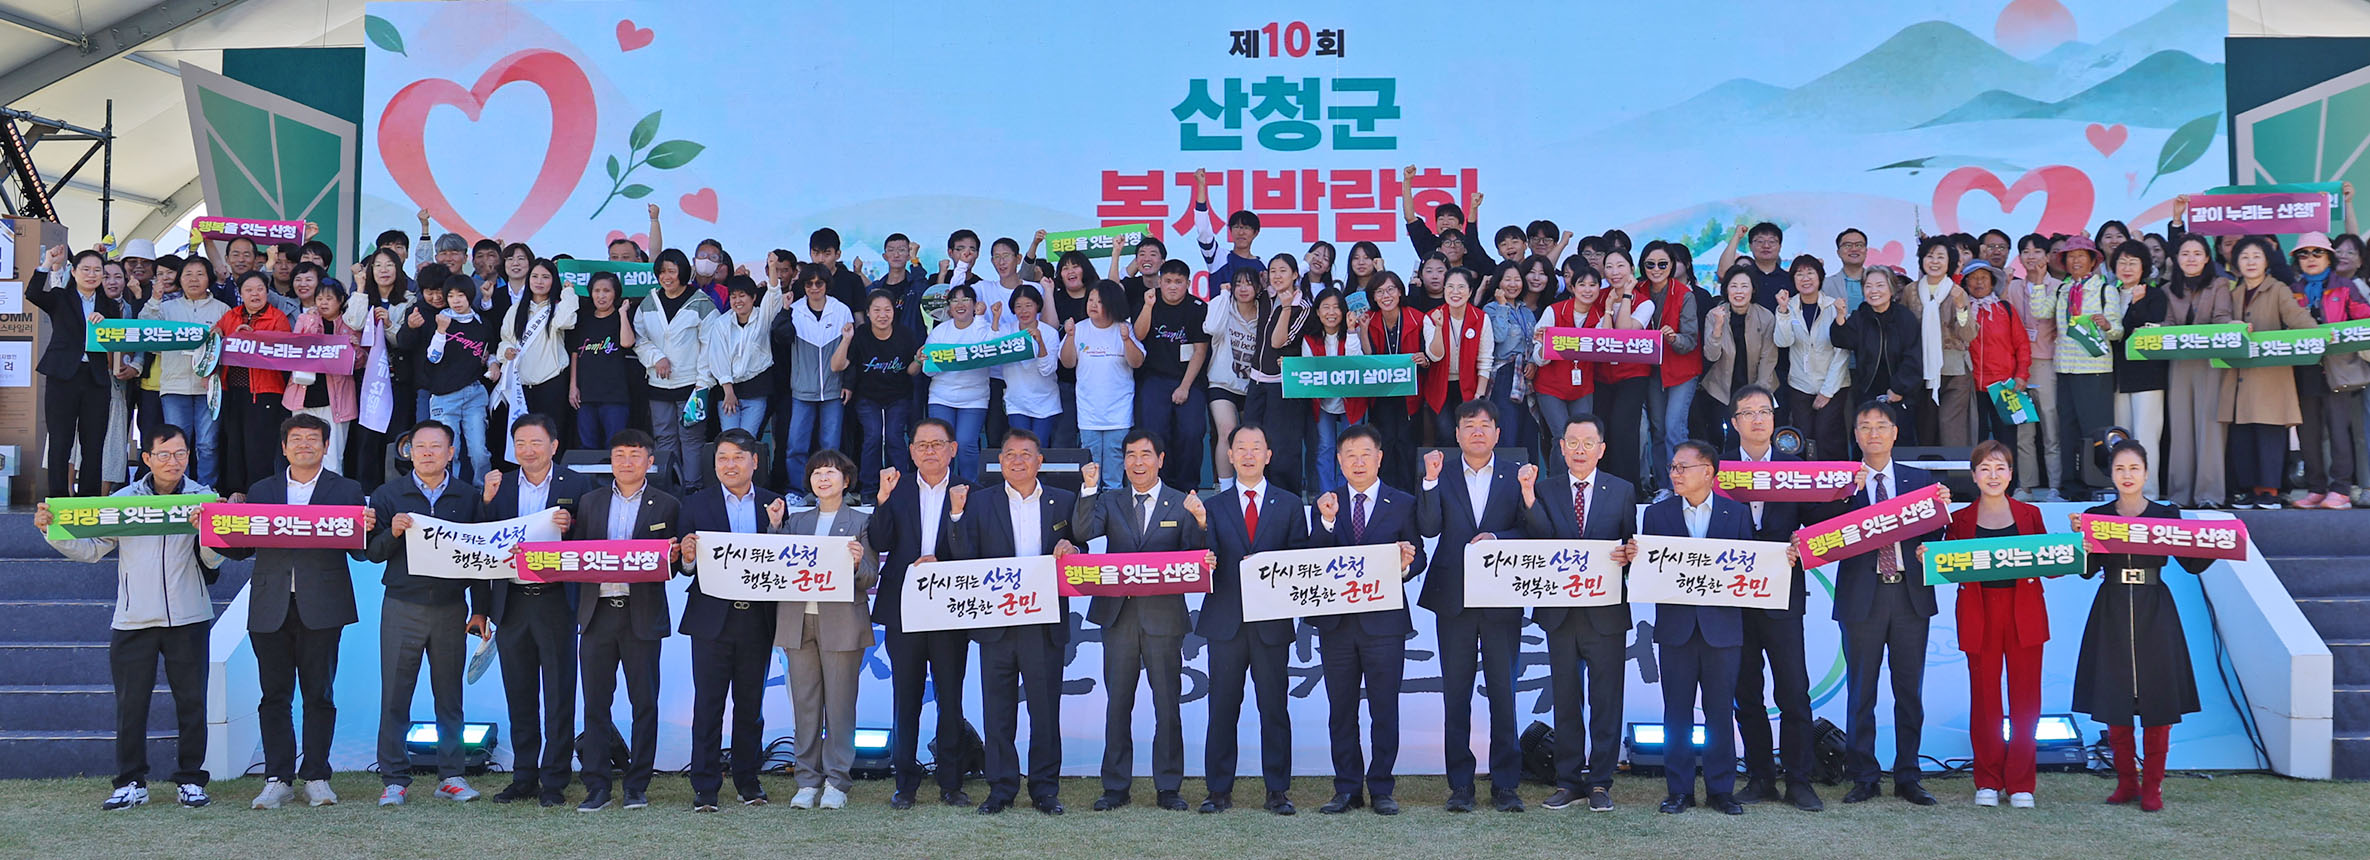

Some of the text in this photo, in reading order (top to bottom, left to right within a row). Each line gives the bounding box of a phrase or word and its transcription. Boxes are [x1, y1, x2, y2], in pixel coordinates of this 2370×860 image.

[1229, 21, 1345, 58] 제10회
[1172, 76, 1401, 151] 산청군
[2191, 206, 2223, 222] 같이
[2226, 205, 2273, 220] 누리는
[199, 220, 297, 240] 행복을 잇는 산청
[1051, 236, 1088, 252] 희망을
[1090, 234, 1113, 249] 잇는
[95, 326, 203, 343] 안부를 잇는 산청
[1551, 334, 1654, 355] 행복을 잇는 산청
[2134, 332, 2242, 352] 희망을 잇는 산청
[225, 338, 256, 354] 같이
[258, 342, 303, 358] 누리는
[578, 336, 618, 358] family
[929, 338, 1027, 364] 안부를 잇는 산청
[2260, 340, 2292, 357] 잇는
[2294, 338, 2326, 355] 산청
[863, 356, 905, 373] family
[1330, 370, 1360, 385] 여기
[1363, 367, 1412, 385] 살아요!
[1717, 469, 1854, 489] 행복을 잇는 산청
[58, 506, 120, 526] 희망을
[124, 506, 164, 524] 잇는
[211, 514, 354, 537] 행복을 잇는 산청
[422, 524, 528, 549] 다시 뛰는 산청
[1808, 500, 1936, 557] 행복을 잇는 산청
[2090, 522, 2237, 550] 행복을 잇는 산청
[452, 551, 498, 570] 행복한
[524, 551, 580, 571] 행복을
[583, 551, 619, 570] 잇는
[621, 551, 660, 570] 산청
[713, 544, 818, 570] 다시 뛰는 산청
[1483, 548, 1590, 577] 다시 뛰는 산청
[1648, 547, 1757, 573] 다시 뛰는 산청
[1933, 545, 2075, 573] 안부를 잇는 산청
[741, 569, 836, 592] 행복한 군민
[917, 567, 1022, 600] 다시 뛰는 산청
[1064, 562, 1201, 585] 행복을 잇는 산청
[1259, 556, 1365, 588] 다시 뛰는 산청
[1290, 580, 1385, 605] 행복한 군민
[1512, 575, 1606, 598] 행복한 군민
[1676, 573, 1771, 598] 행복한 군민
[947, 592, 1042, 617] 행복한 군민
